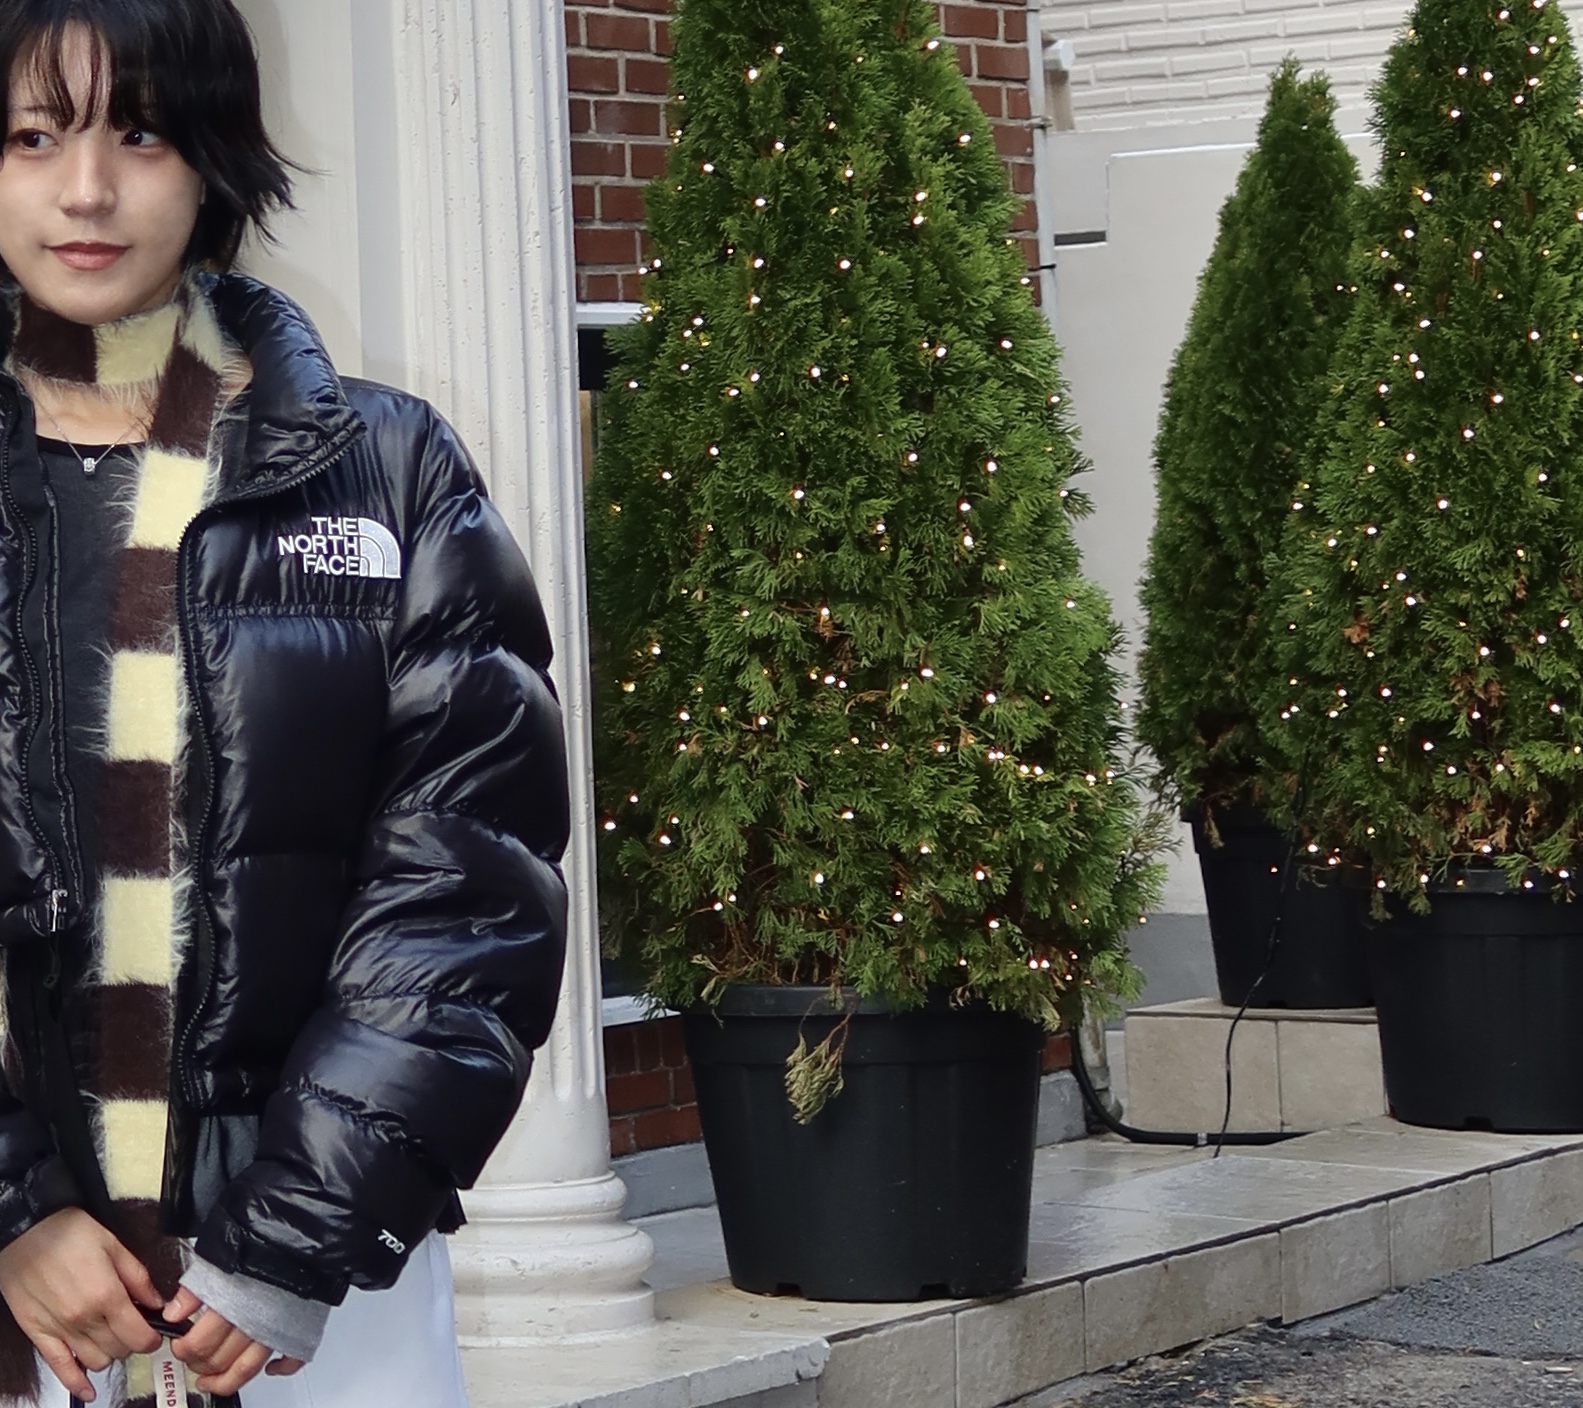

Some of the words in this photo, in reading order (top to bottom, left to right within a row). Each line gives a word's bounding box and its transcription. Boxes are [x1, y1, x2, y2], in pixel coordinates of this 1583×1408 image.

[311, 516, 359, 536] THE
[277, 535, 359, 555] NORTH
[303, 554, 360, 575] FACE
[378, 1229, 406, 1254] 700
